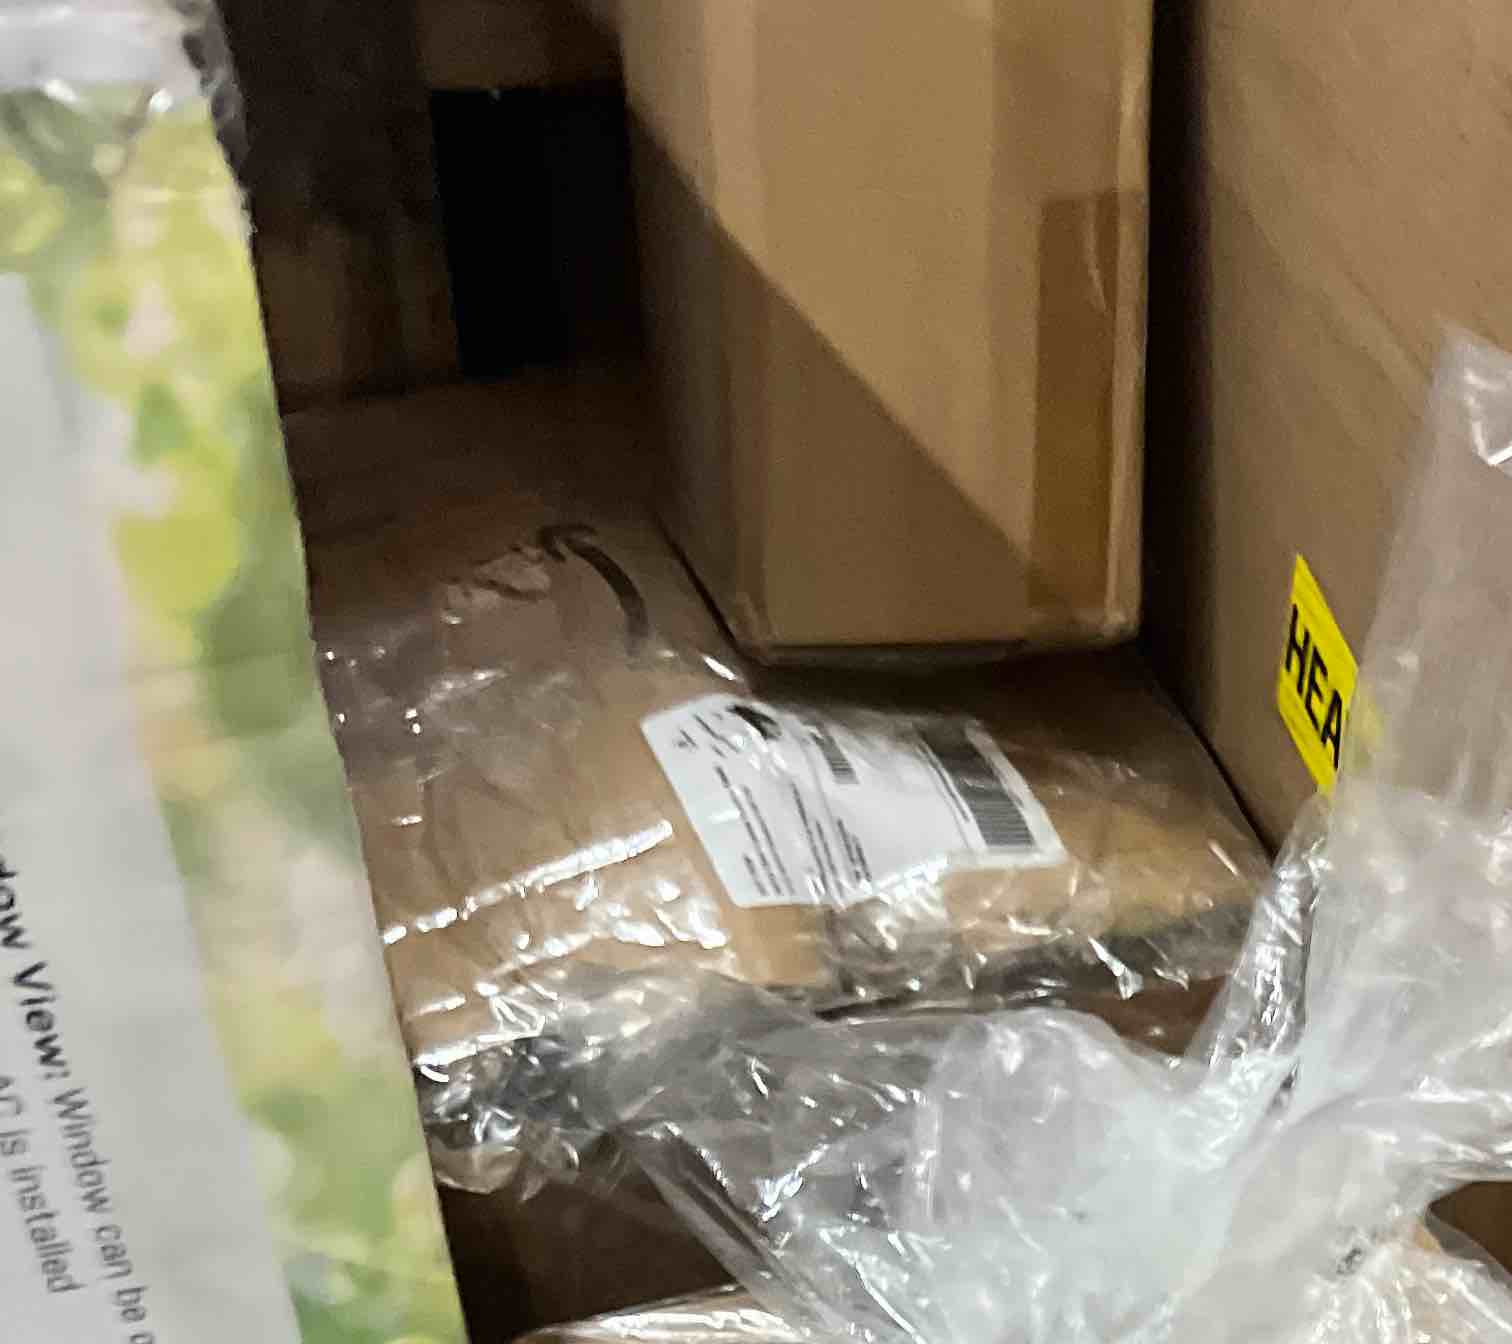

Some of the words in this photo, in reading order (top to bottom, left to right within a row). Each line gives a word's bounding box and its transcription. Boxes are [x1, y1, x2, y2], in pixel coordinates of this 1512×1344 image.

[1285, 602, 1343, 771] HEA
[11, 960, 71, 1080] View:
[53, 1086, 114, 1214] Window
[94, 1224, 134, 1282] can
[115, 1285, 150, 1323] be
[10, 1164, 88, 1293] installed
